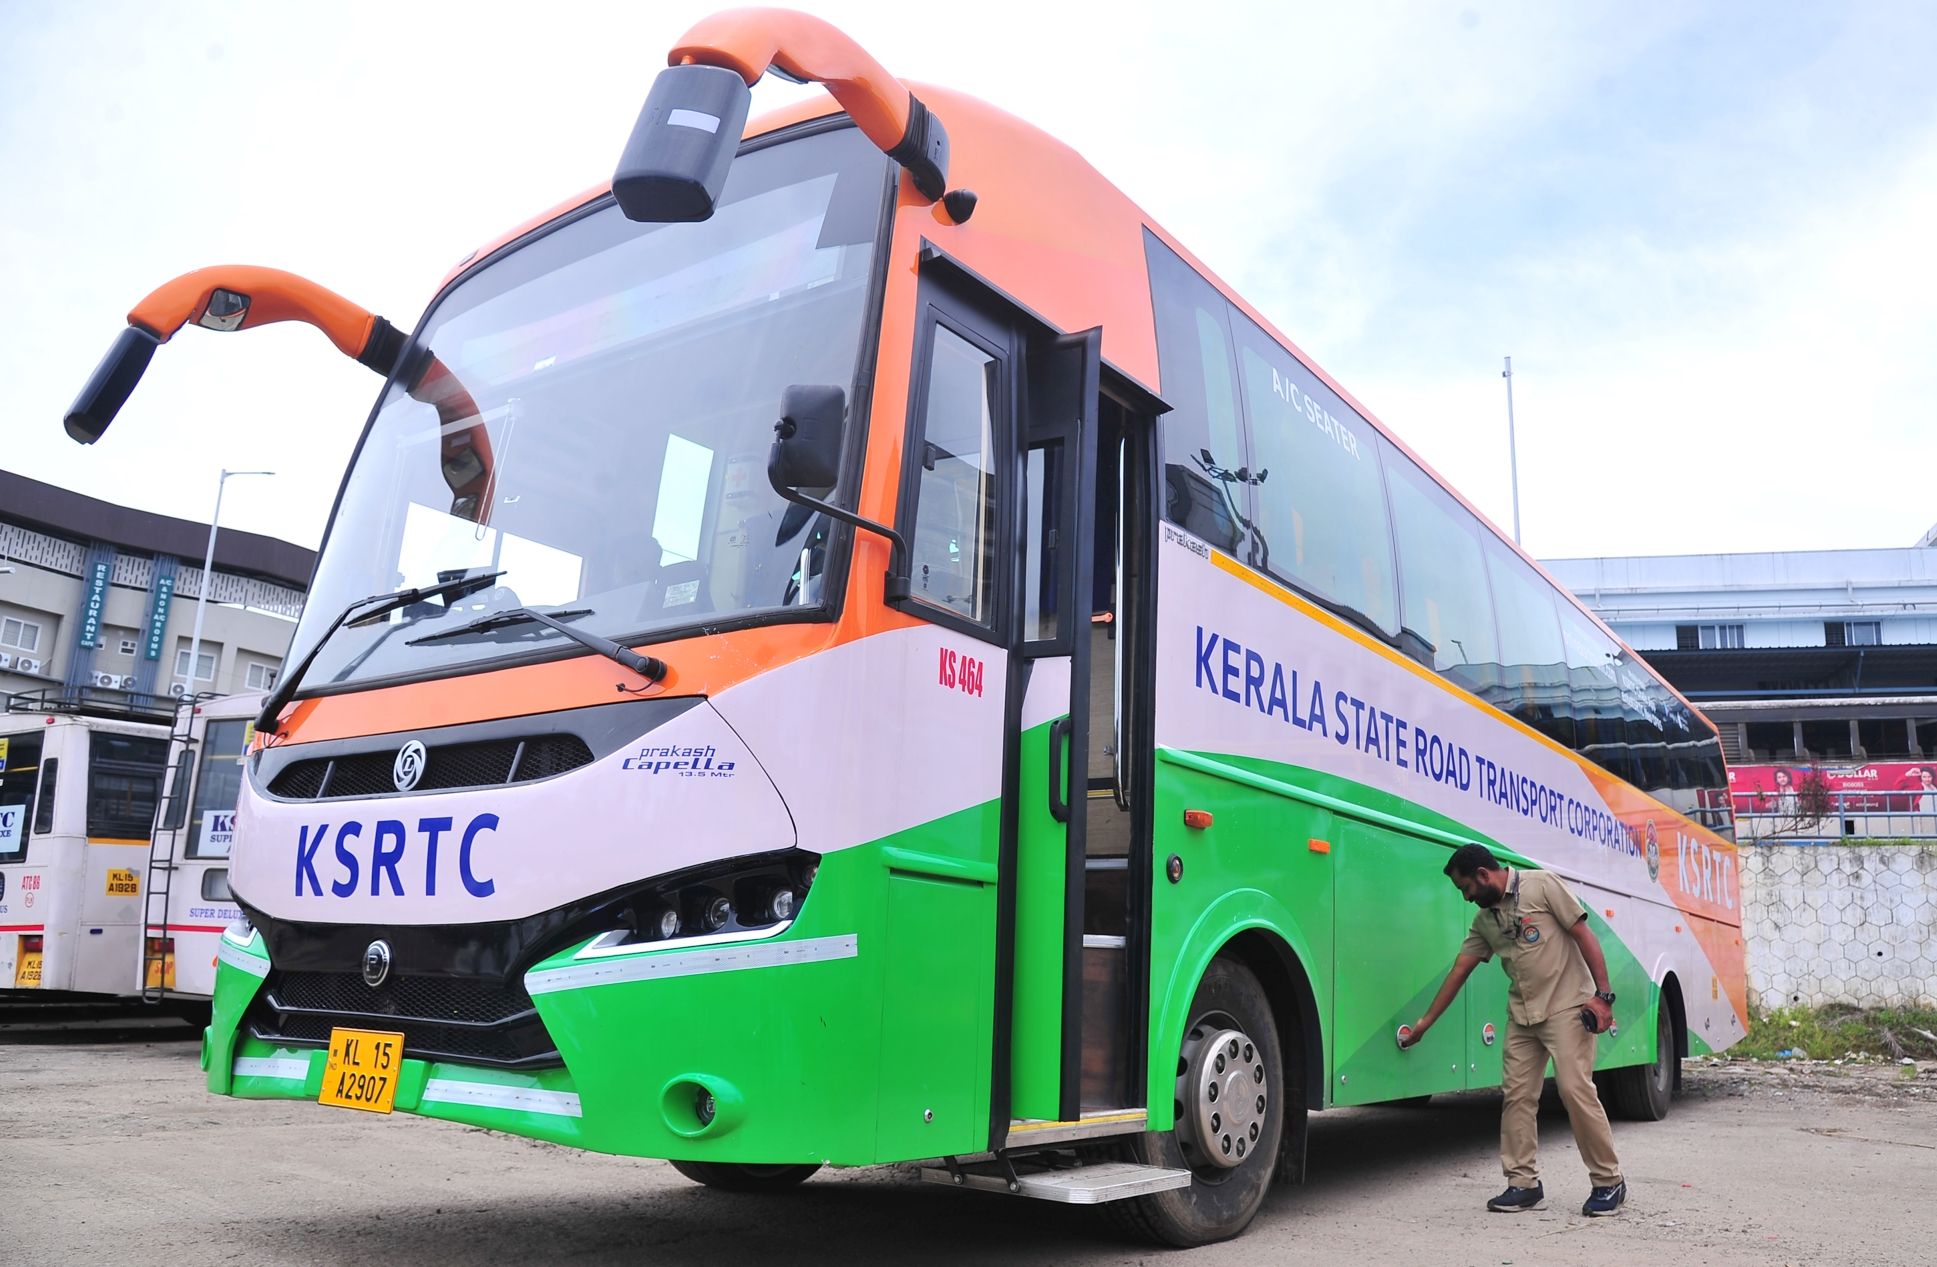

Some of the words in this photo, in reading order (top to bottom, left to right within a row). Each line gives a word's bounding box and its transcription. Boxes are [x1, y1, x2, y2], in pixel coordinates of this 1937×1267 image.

[1272, 367, 1302, 413] A/C
[1304, 394, 1360, 461] SEATER
[85, 564, 106, 640] RESTAURANT
[939, 647, 956, 689] KS
[958, 655, 983, 698] 464
[639, 745, 716, 760] prakash
[1195, 625, 1328, 738] KERALA
[1334, 690, 1408, 769] STATE
[1414, 726, 1471, 792] ROAD
[1475, 755, 1564, 830] TRANSPORT
[1567, 798, 1642, 859] CORPORATION
[295, 812, 500, 898] KSRTC
[1677, 831, 1734, 910] KSRTC
[108, 882, 137, 893] A1928
[190, 908, 215, 918] SUPER
[343, 1038, 361, 1066] KL
[374, 1041, 393, 1070] 15
[335, 1071, 388, 1104] A2907
